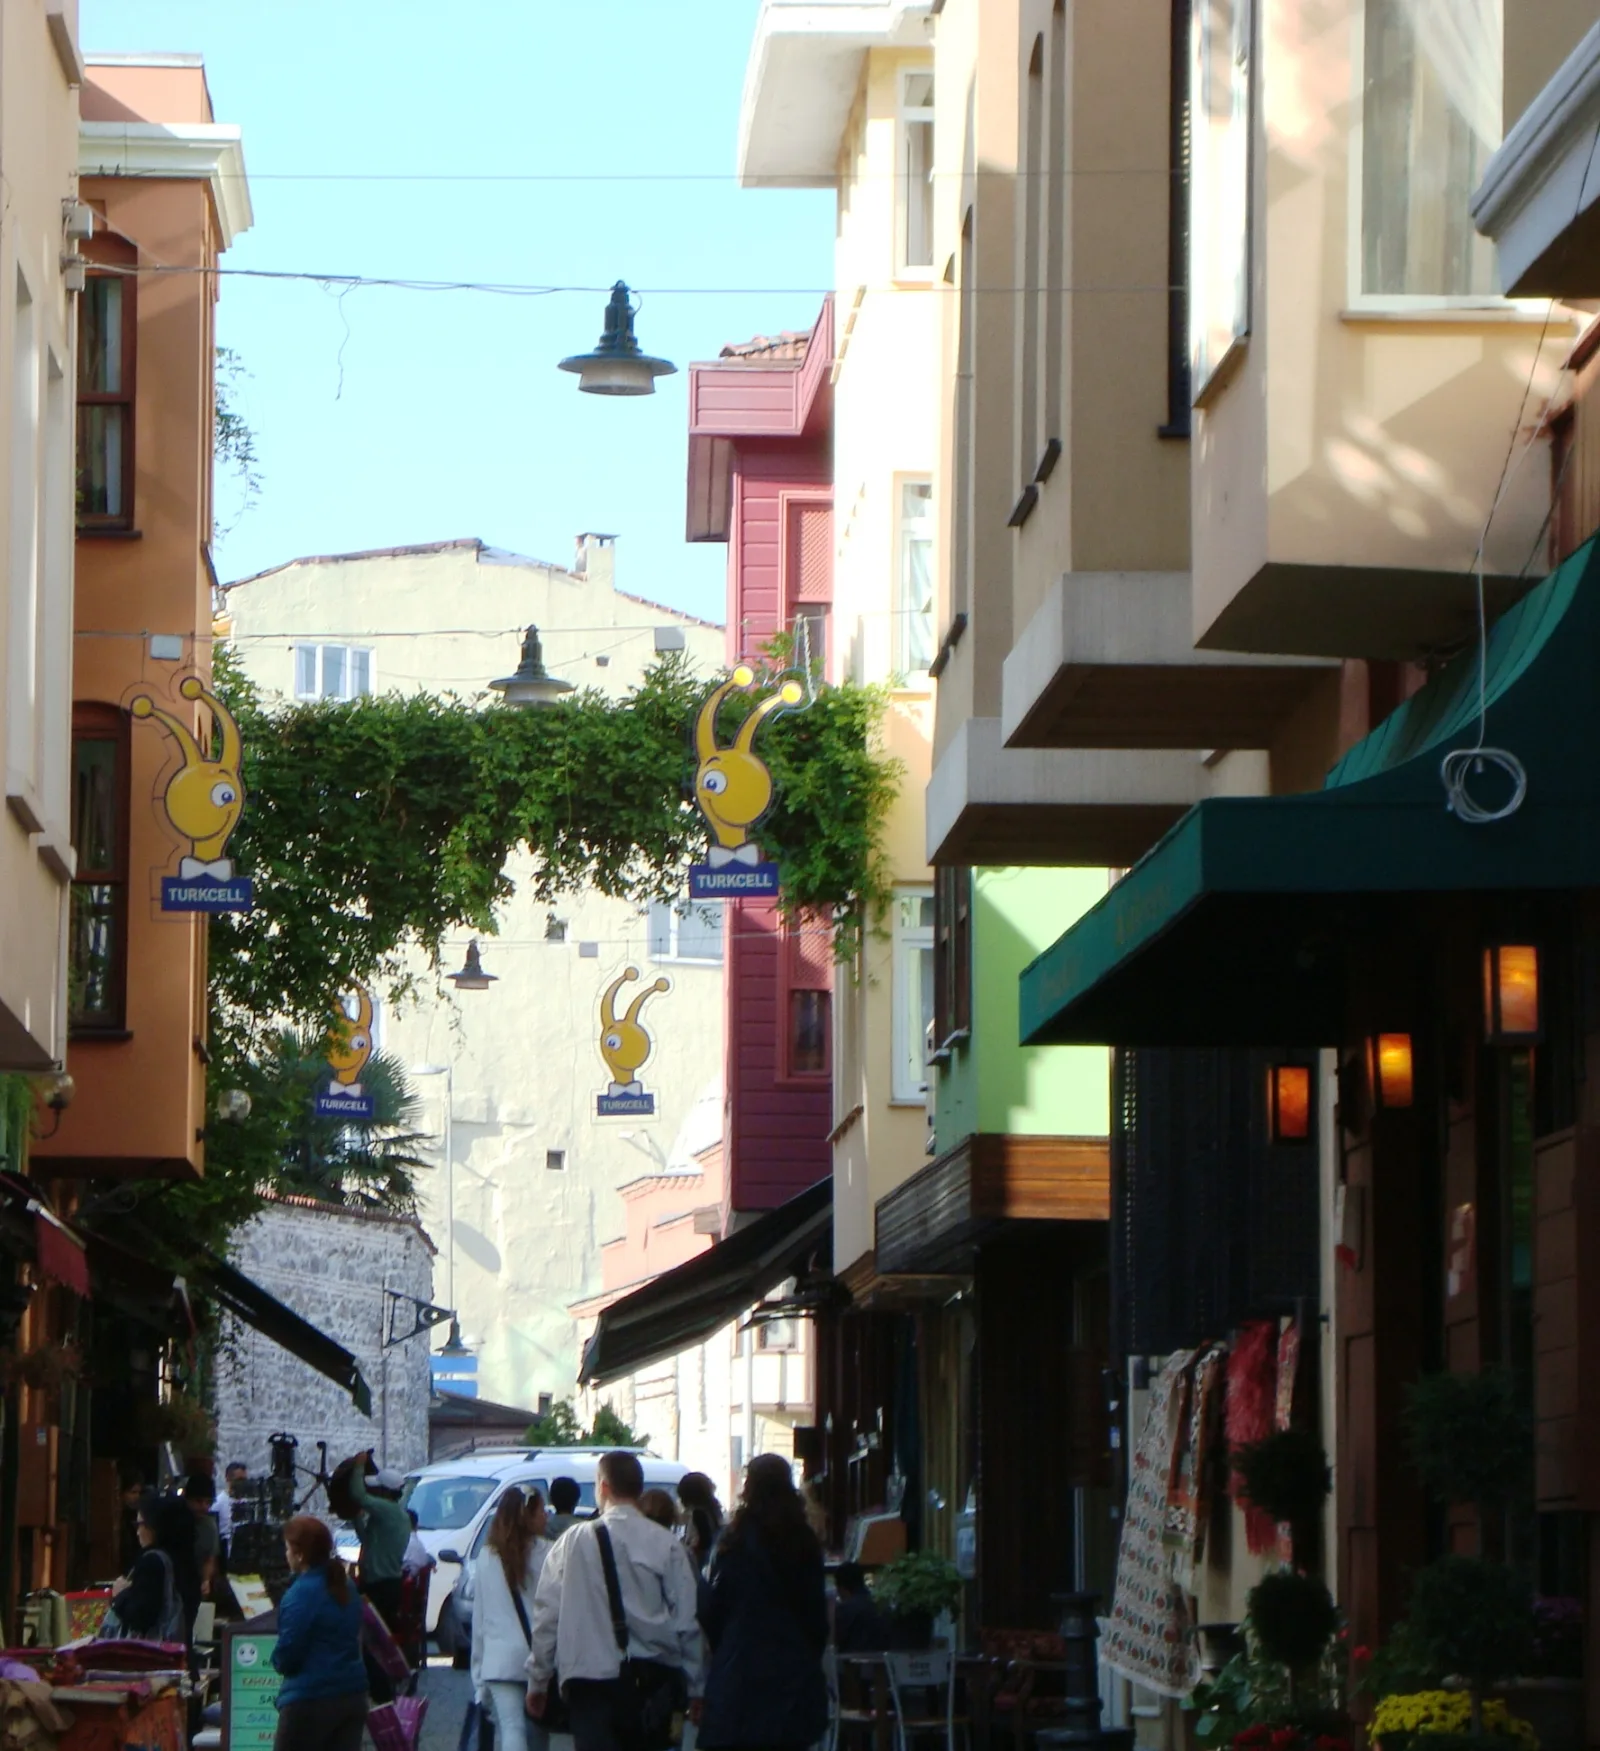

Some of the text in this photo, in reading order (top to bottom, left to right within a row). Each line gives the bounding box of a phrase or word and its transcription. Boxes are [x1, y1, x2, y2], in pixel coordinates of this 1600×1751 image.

[696, 873, 773, 889] TURKCELL
[168, 887, 244, 903] TURKCELL
[320, 1098, 368, 1111] TURKCELL
[602, 1099, 649, 1111] TURKCELL
